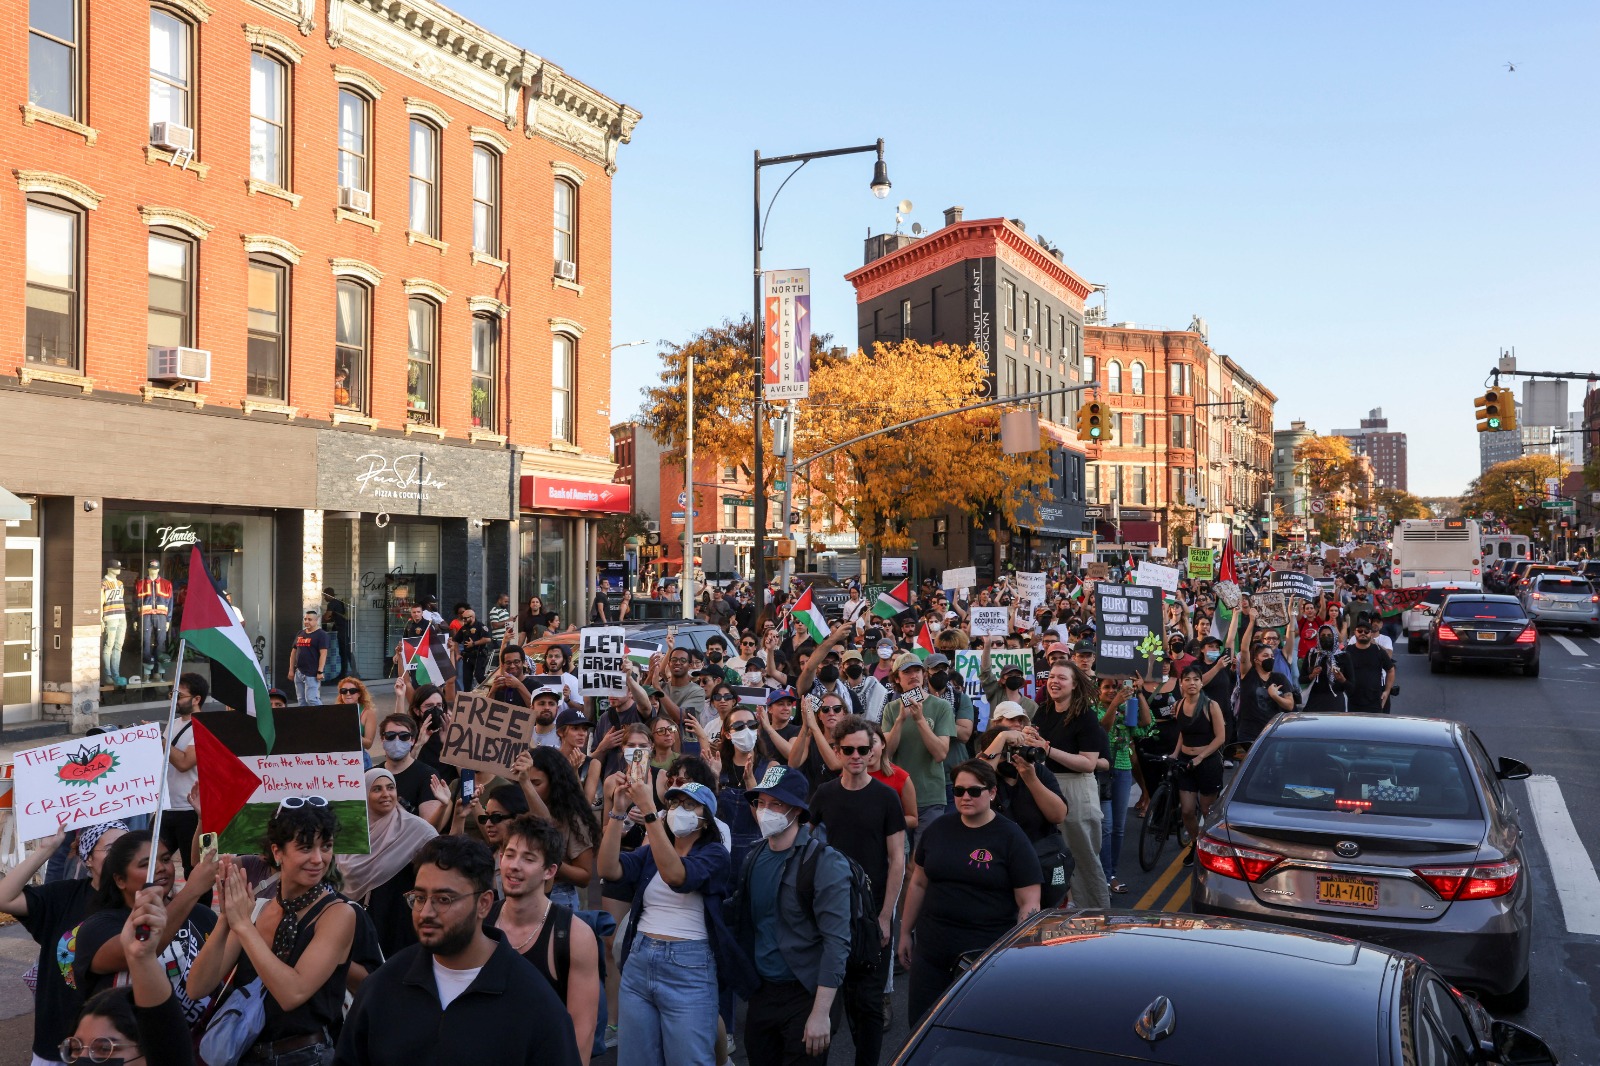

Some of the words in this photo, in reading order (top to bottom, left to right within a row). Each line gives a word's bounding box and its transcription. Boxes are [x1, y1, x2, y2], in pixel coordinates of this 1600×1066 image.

[771, 285, 804, 294] NORTH
[973, 268, 981, 309] PLANT
[770, 385, 804, 393] AVENUE
[374, 489, 392, 498] PIZZA
[399, 491, 429, 500] COCKTAILS
[548, 486, 566, 499] Bank
[565, 488, 573, 499] of
[573, 488, 598, 502] America
[868, 586, 887, 595] FREE
[1102, 596, 1128, 611] BURY
[1131, 599, 1146, 613] US.
[1105, 625, 1121, 636] WE
[1122, 626, 1148, 636] WERE
[584, 635, 624, 654] LET
[583, 656, 623, 671] GAZA
[956, 653, 1032, 678] PAESTINE
[453, 694, 531, 740] FREE
[15, 746, 66, 767] THE
[104, 727, 159, 745] WORLD
[72, 761, 107, 777] GAZA
[257, 758, 280, 769] From
[280, 756, 293, 767] the
[294, 756, 314, 766] River
[315, 755, 325, 766] to
[326, 755, 339, 766] the
[341, 753, 360, 766] Sea
[262, 774, 304, 793] Palestine
[305, 776, 320, 790] will
[322, 776, 335, 789] be
[337, 774, 361, 788] Free
[25, 789, 97, 816] CRIES
[105, 775, 155, 795] WITH
[1323, 883, 1341, 899] JCA
[1348, 885, 1373, 902] 7410
